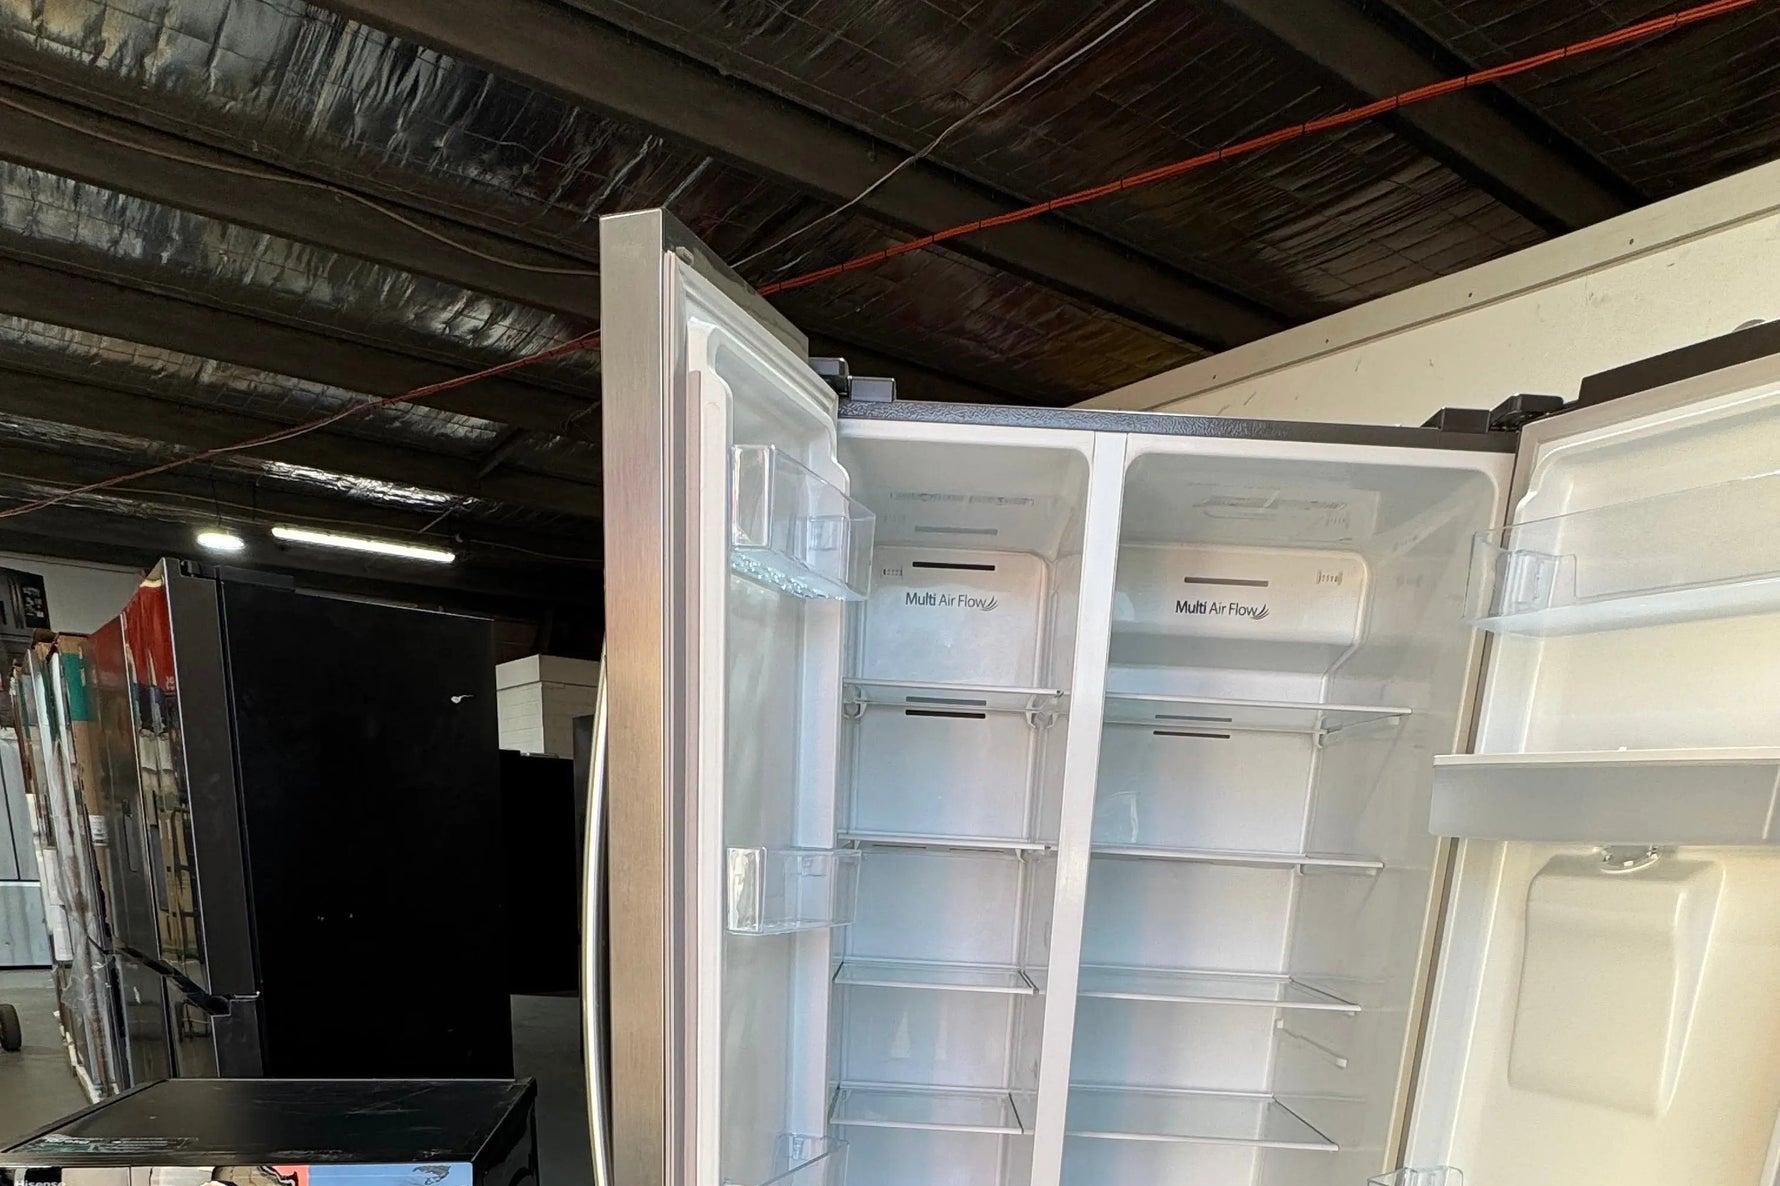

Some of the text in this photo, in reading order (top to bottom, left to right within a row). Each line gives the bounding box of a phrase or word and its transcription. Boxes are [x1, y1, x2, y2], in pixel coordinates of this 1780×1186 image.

[905, 591, 988, 610] Multi Air Flow
[1175, 600, 1258, 618] Multi Air Flow
